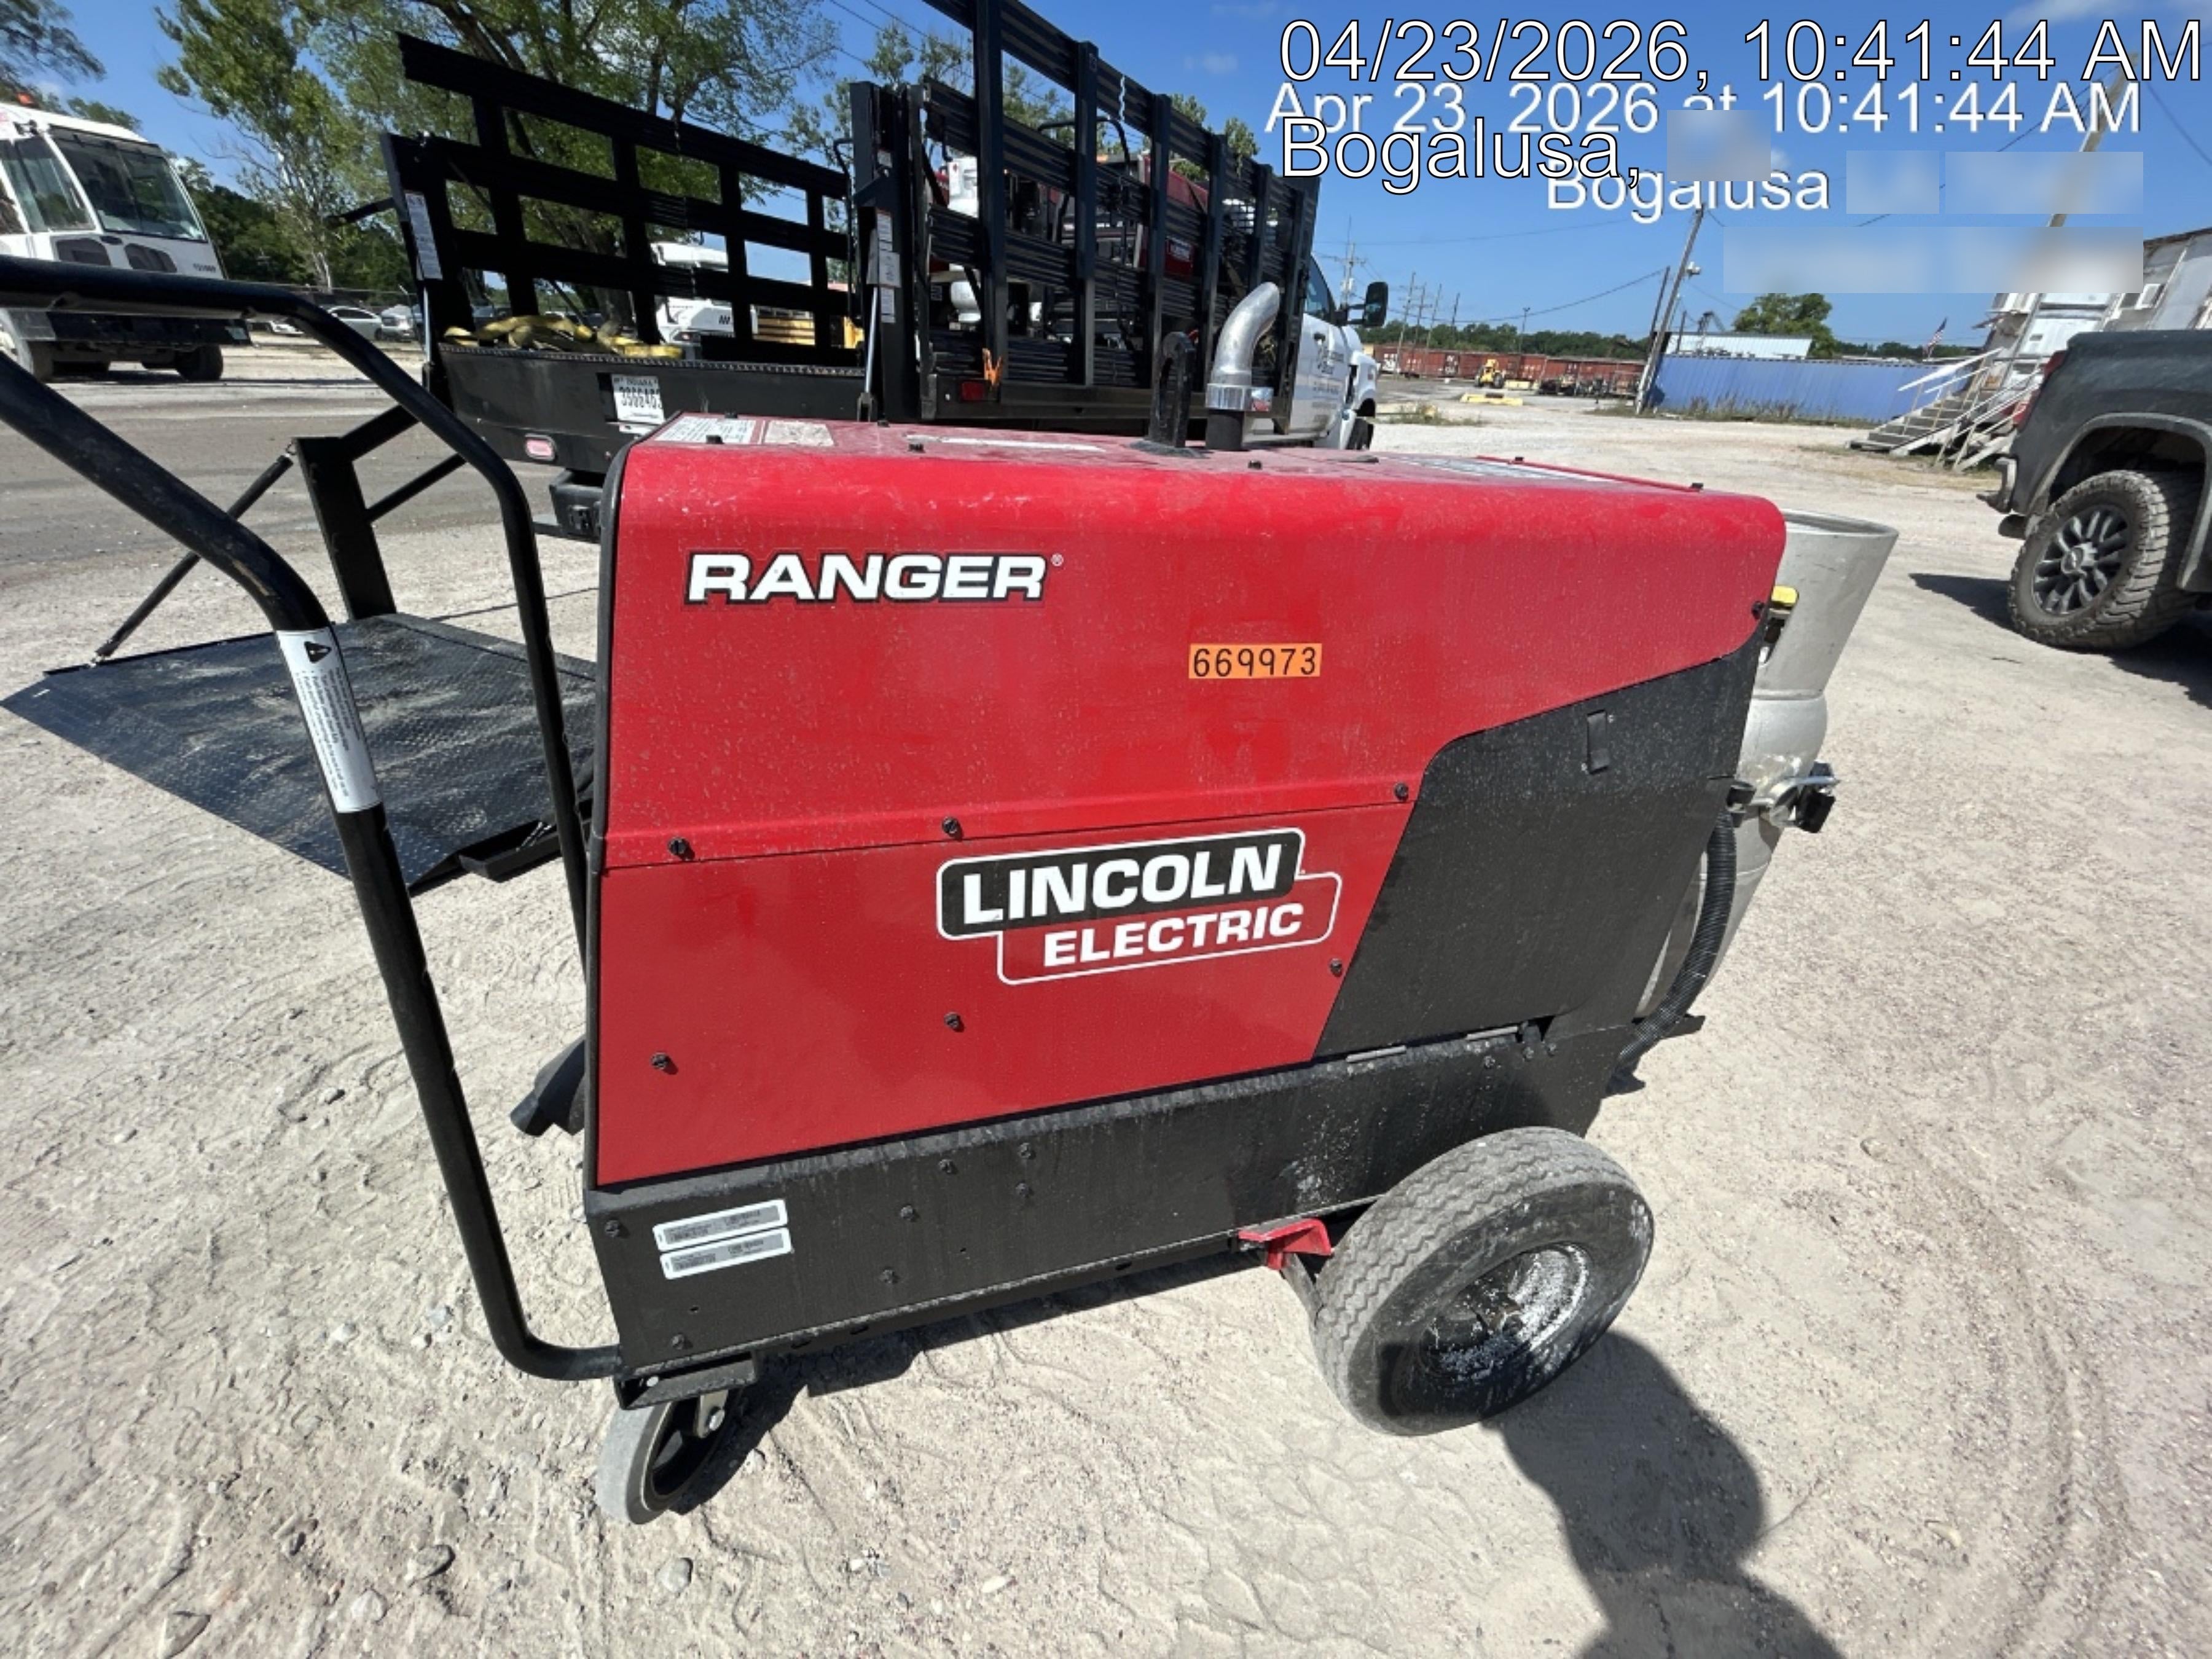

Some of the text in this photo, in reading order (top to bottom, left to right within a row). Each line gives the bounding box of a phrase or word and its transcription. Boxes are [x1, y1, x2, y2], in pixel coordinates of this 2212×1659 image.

[684, 552, 1048, 605] RANGER
[1193, 646, 1316, 677] 669973
[963, 844, 1282, 925] LINCOLN
[1043, 902, 1304, 967] ELECTRIC
